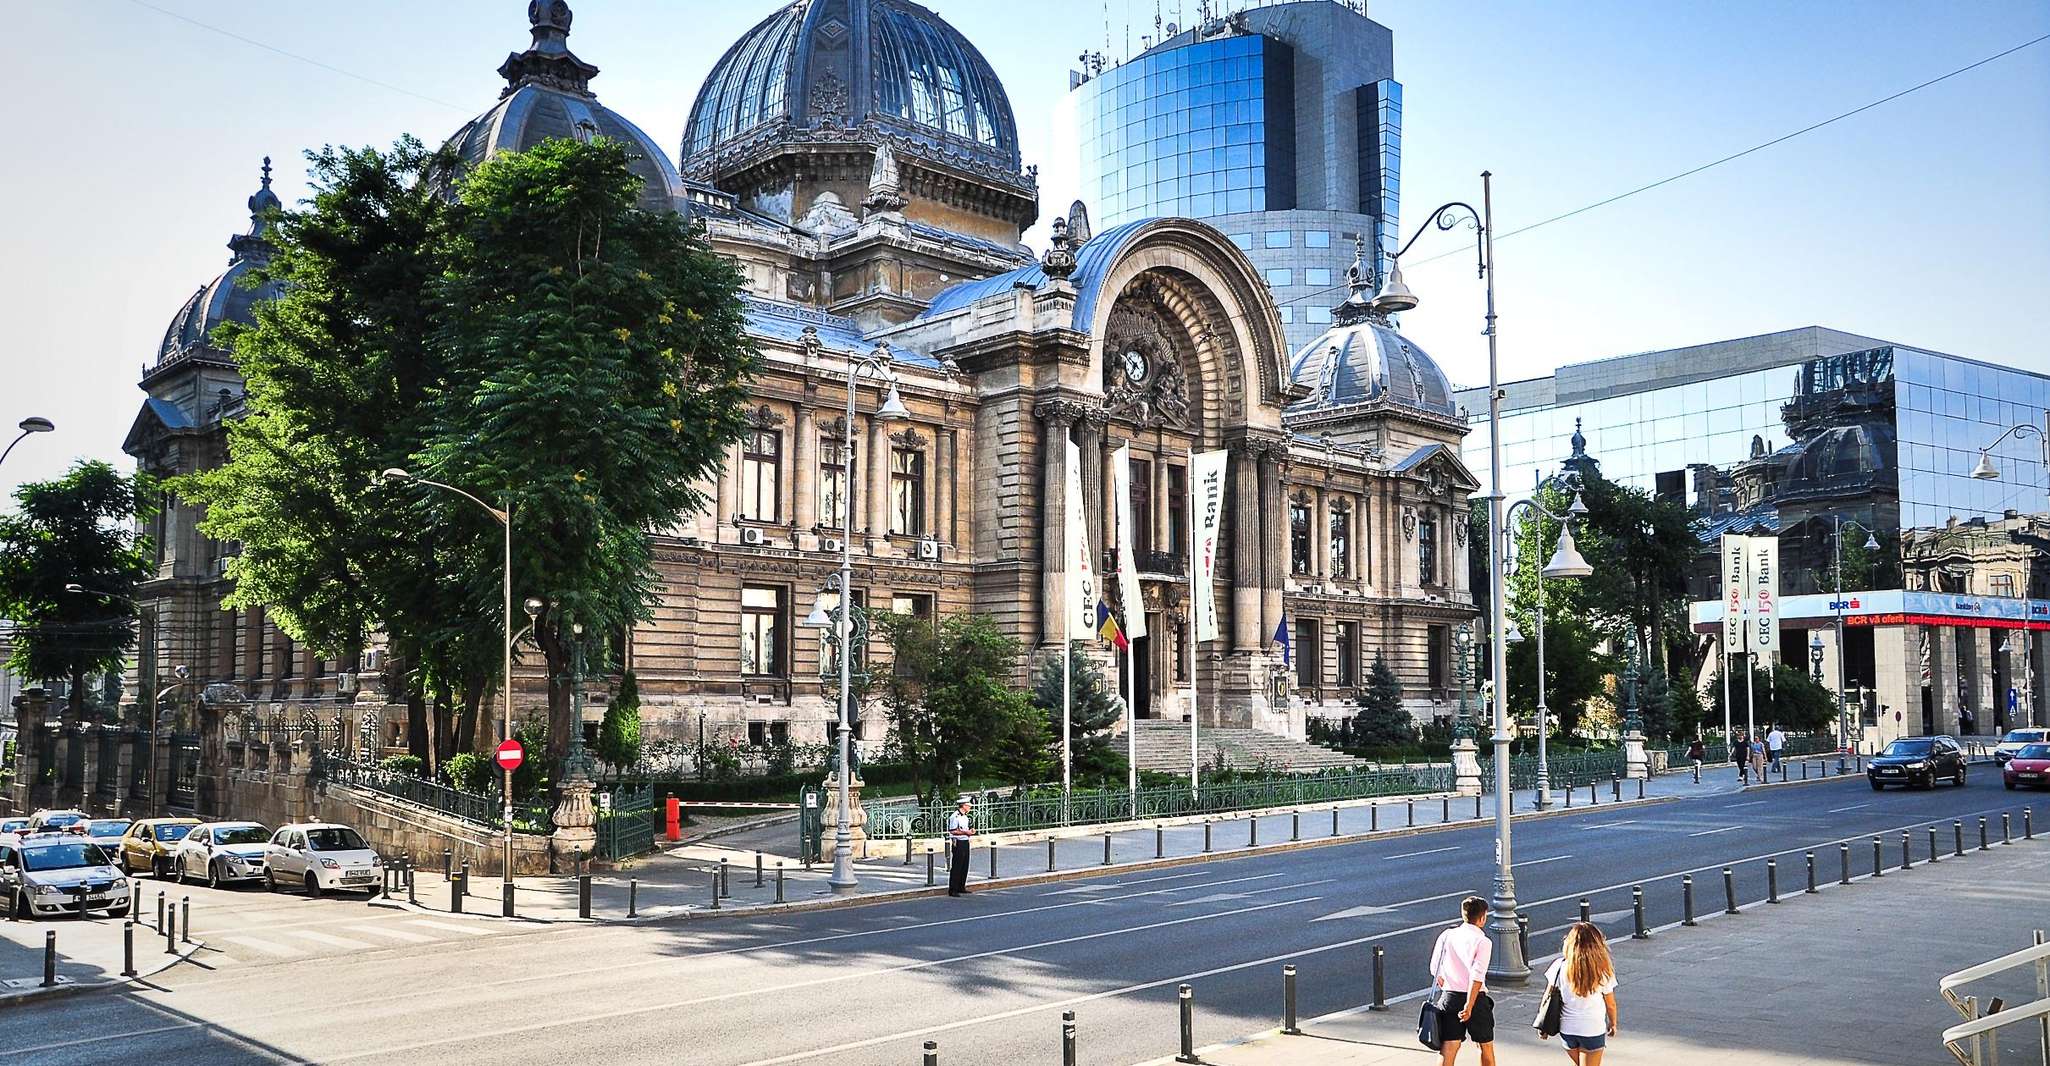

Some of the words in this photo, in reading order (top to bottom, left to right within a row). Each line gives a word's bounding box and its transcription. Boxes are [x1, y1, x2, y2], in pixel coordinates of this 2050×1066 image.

[1732, 546, 1741, 584] Bank
[1758, 548, 1770, 585] Bank
[1082, 580, 1094, 629] CEC
[1731, 588, 1741, 613] 150
[1759, 589, 1774, 614] 150
[1829, 601, 1850, 611] BCR
[1729, 617, 1738, 647] CEC
[1759, 617, 1771, 646] CEC
[1846, 615, 1868, 625] BCR
